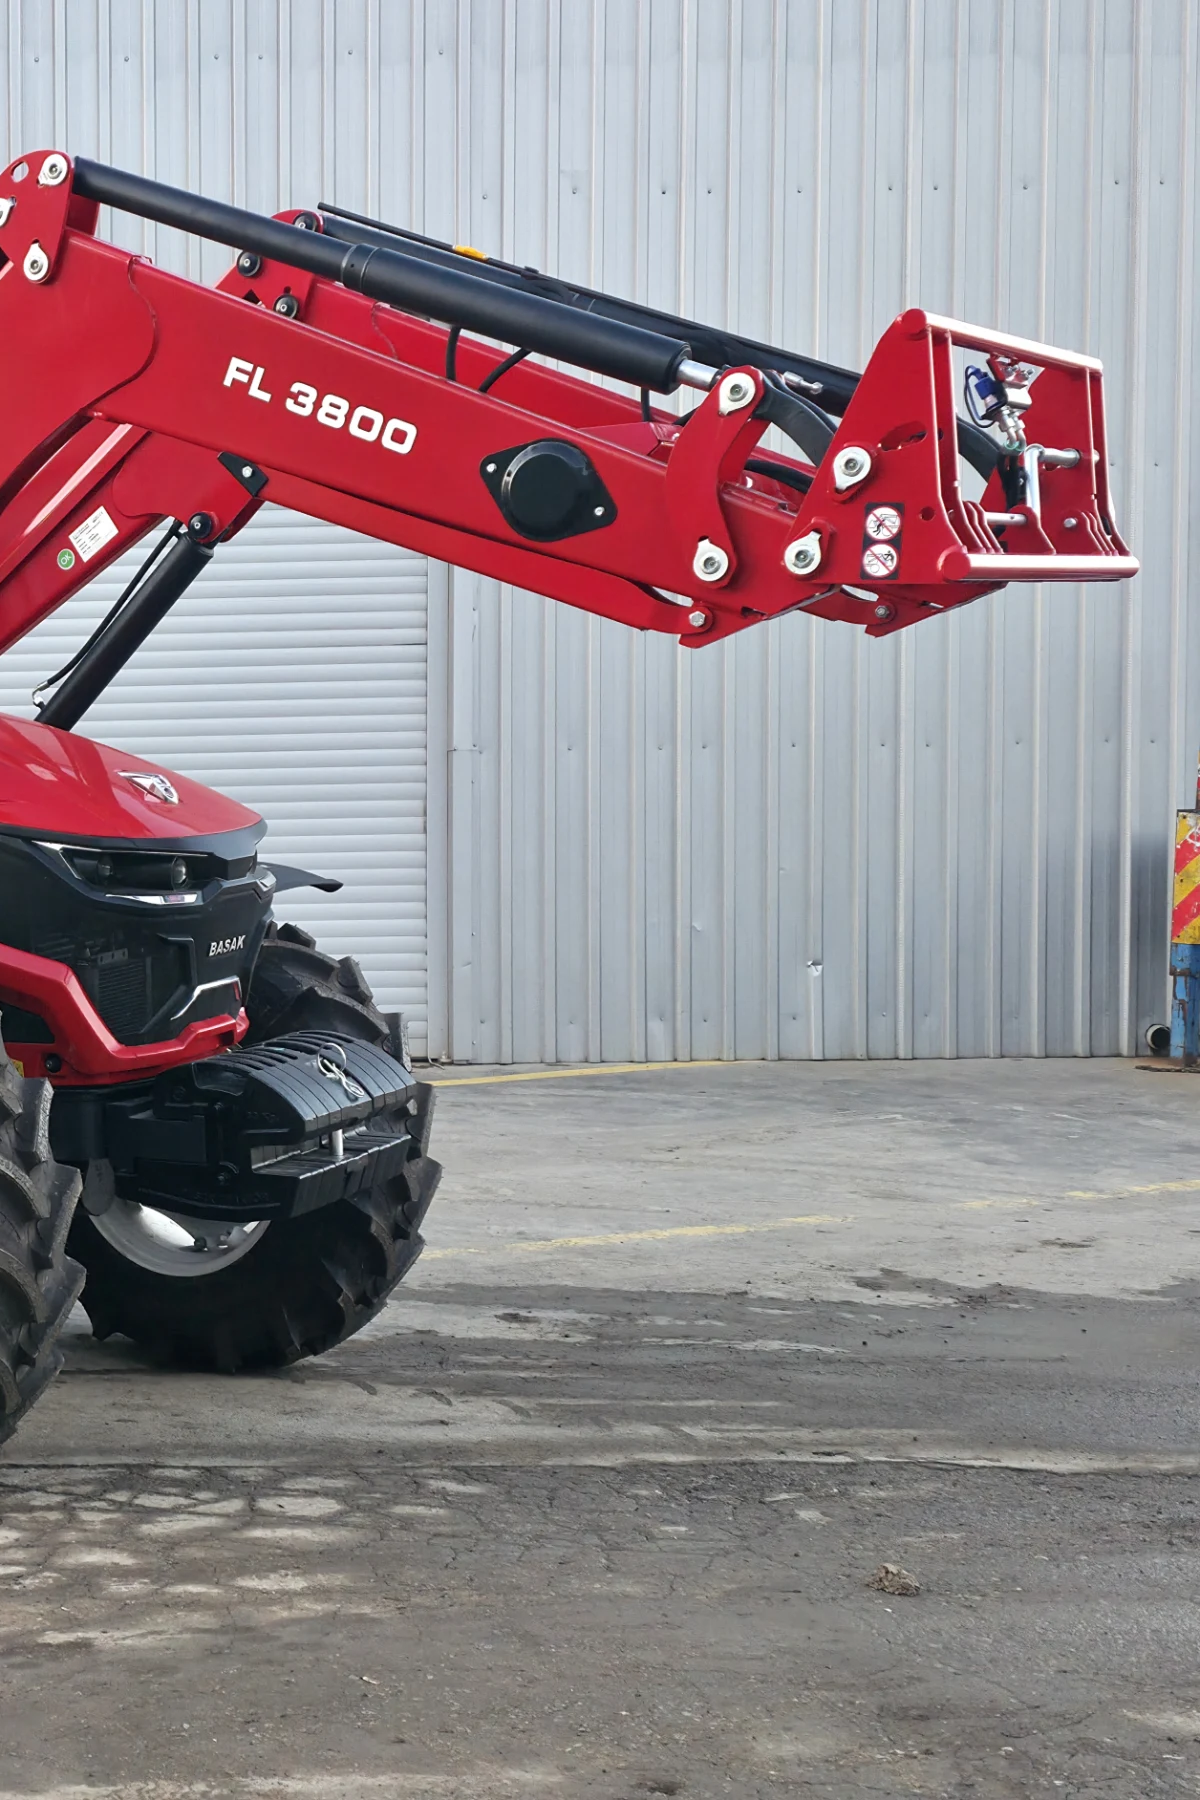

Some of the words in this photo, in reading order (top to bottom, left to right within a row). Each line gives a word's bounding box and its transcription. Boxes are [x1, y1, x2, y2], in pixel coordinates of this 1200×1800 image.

[223, 357, 272, 403] FL
[285, 381, 418, 455] 3800
[60, 552, 72, 566] OK
[208, 934, 247, 957] BASAK
